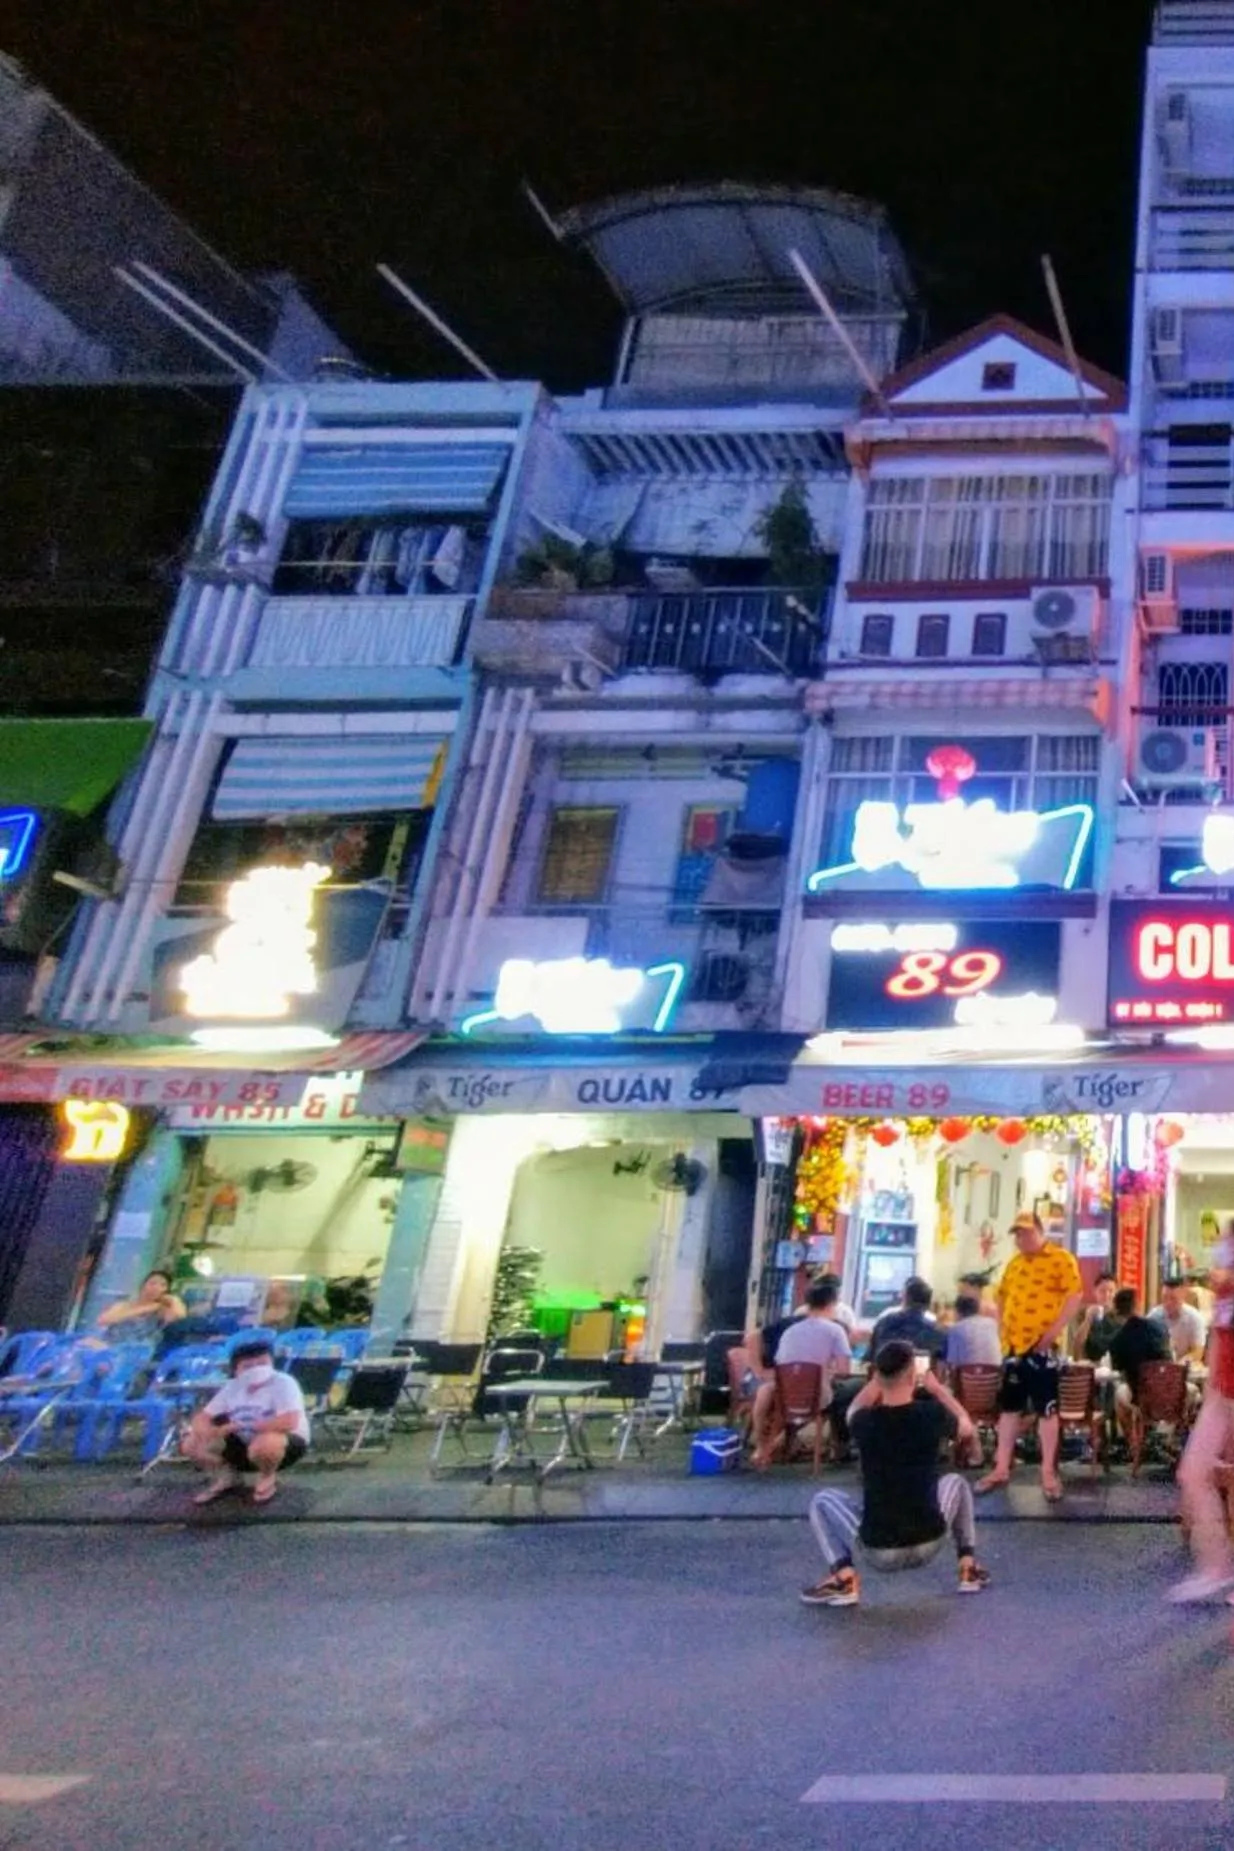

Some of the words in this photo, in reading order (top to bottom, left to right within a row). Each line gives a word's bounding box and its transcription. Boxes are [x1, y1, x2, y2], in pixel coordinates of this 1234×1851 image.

[885, 951, 1002, 998] 89
[237, 1081, 282, 1101] 85
[449, 1074, 515, 1108] Tiger
[822, 1082, 894, 1108] BEER
[908, 1082, 950, 1108] 89
[1074, 1072, 1145, 1107] Tiger
